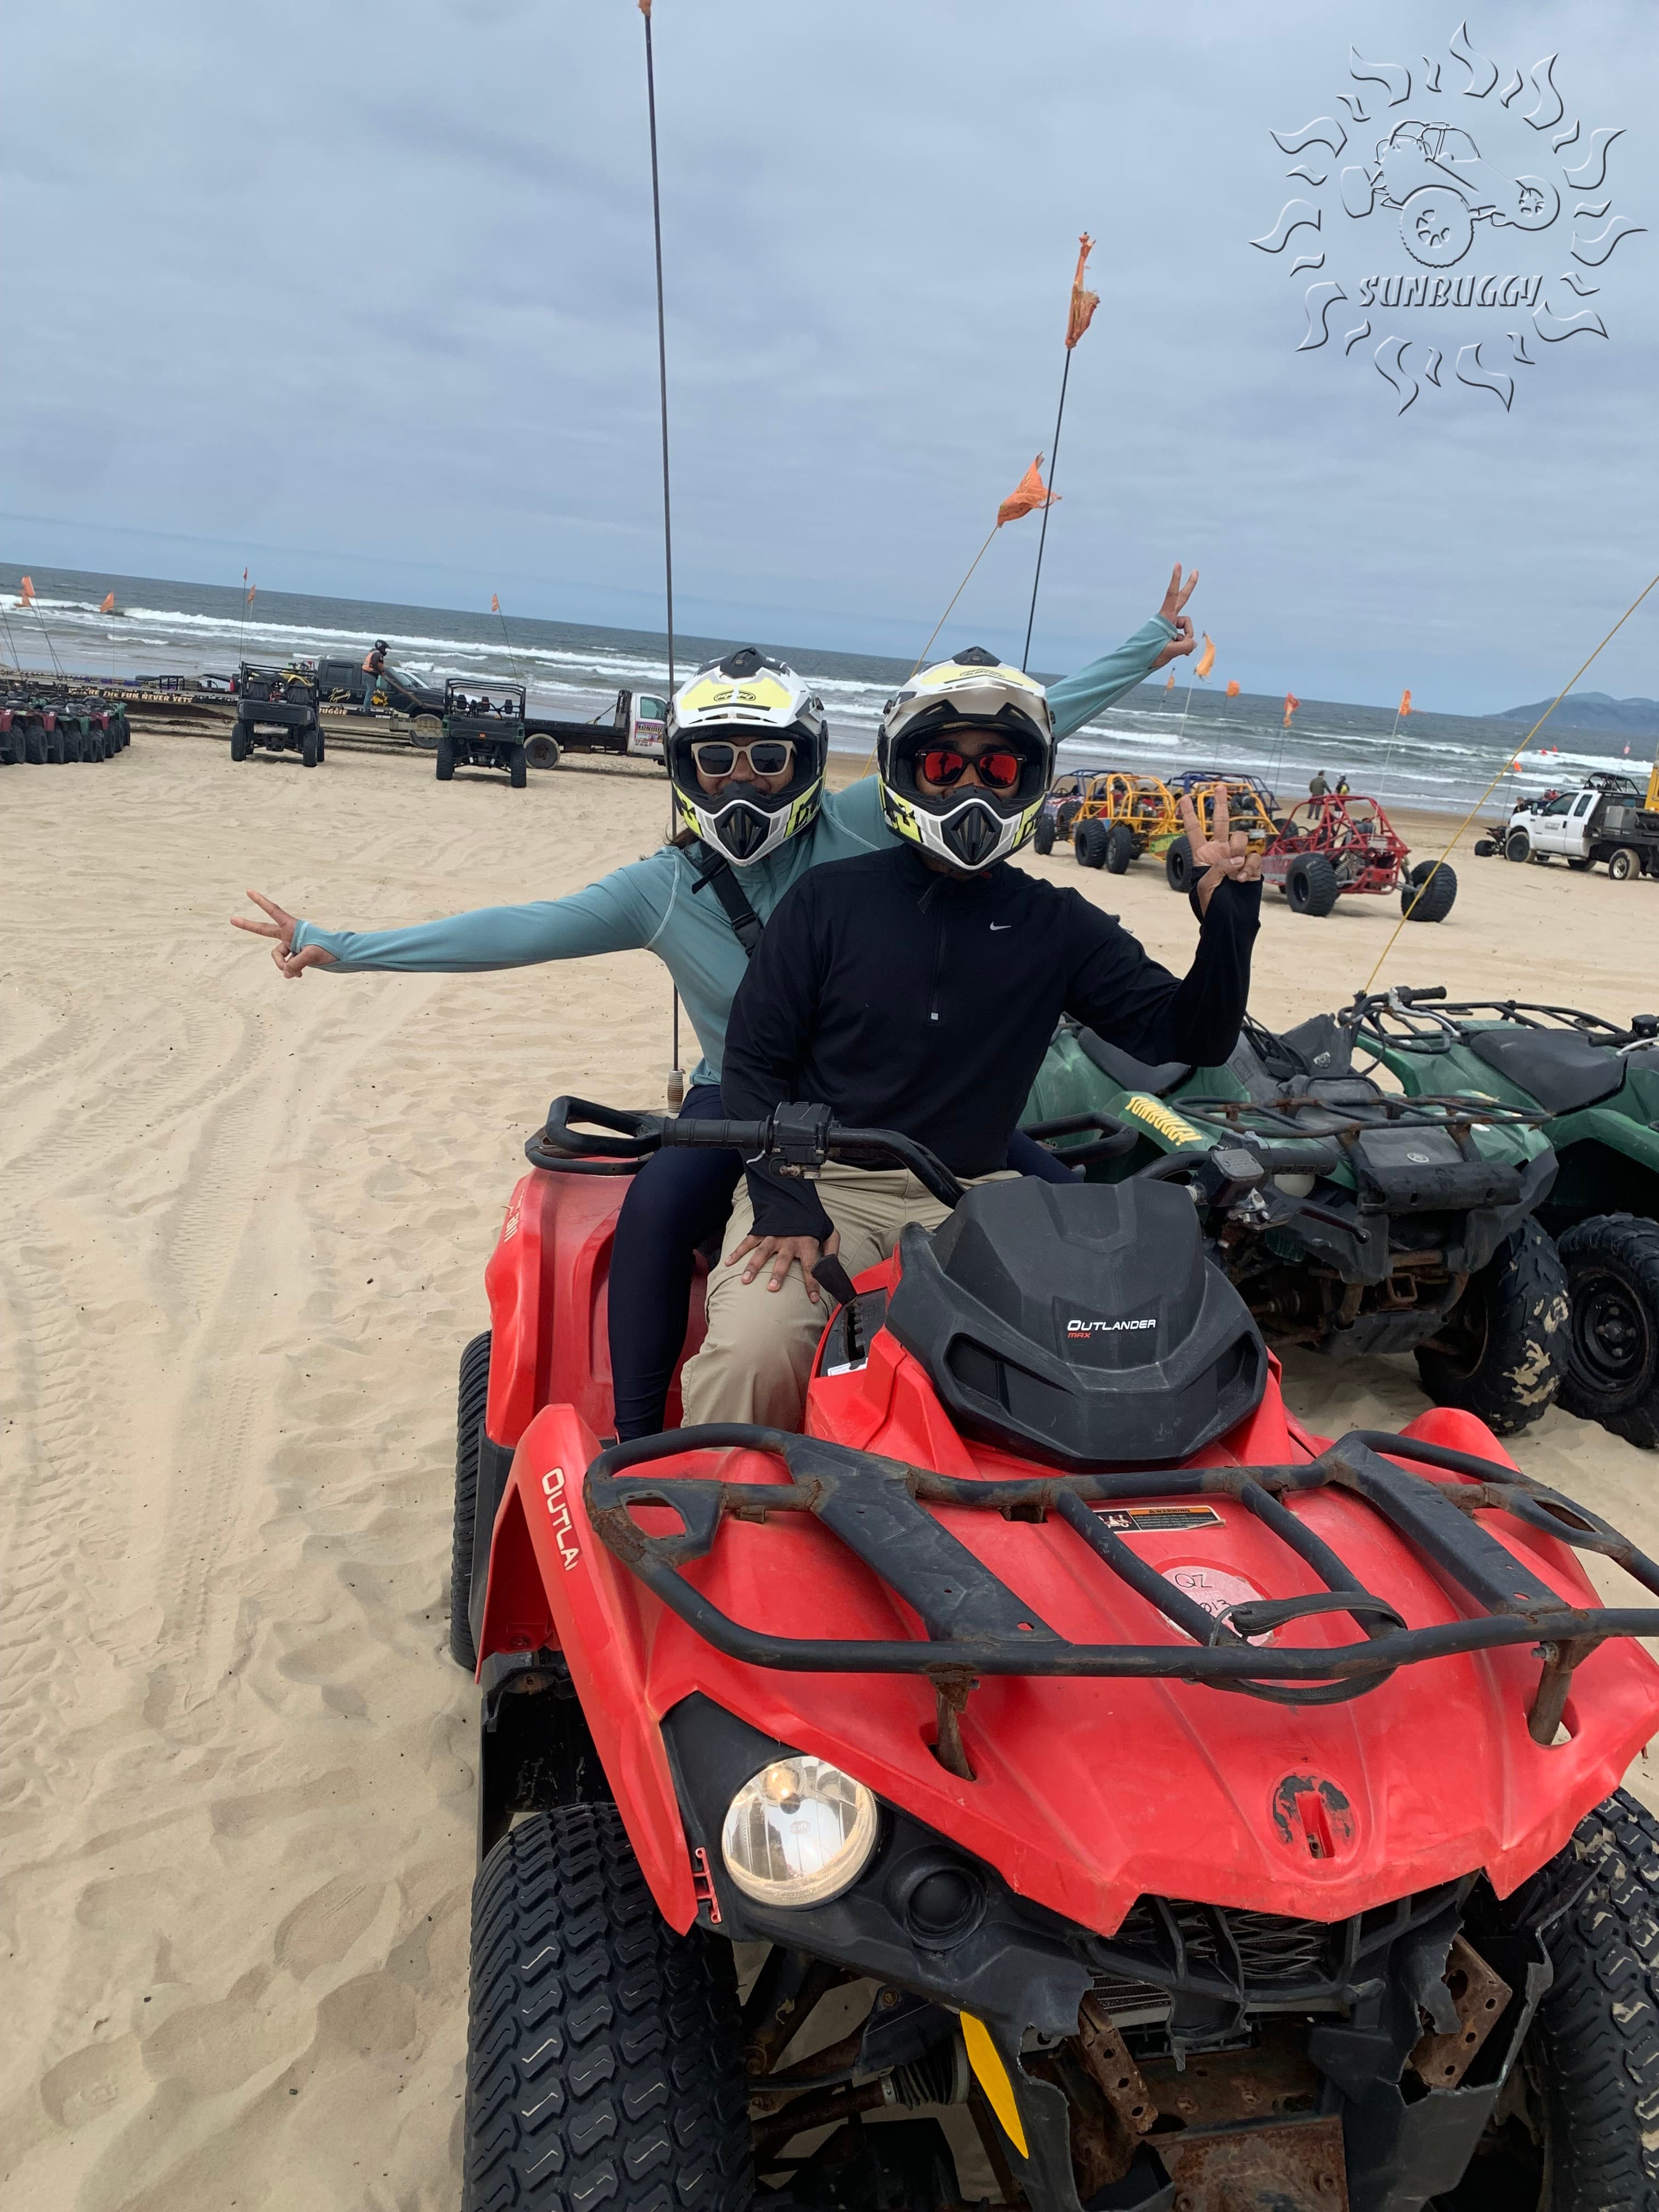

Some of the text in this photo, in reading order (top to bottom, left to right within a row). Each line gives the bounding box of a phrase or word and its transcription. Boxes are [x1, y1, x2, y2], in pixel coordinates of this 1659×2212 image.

[142, 692, 170, 702] NEVER
[1125, 1096, 1203, 1146] SUNBUGGY
[1067, 1319, 1156, 1331] OUTLANDER
